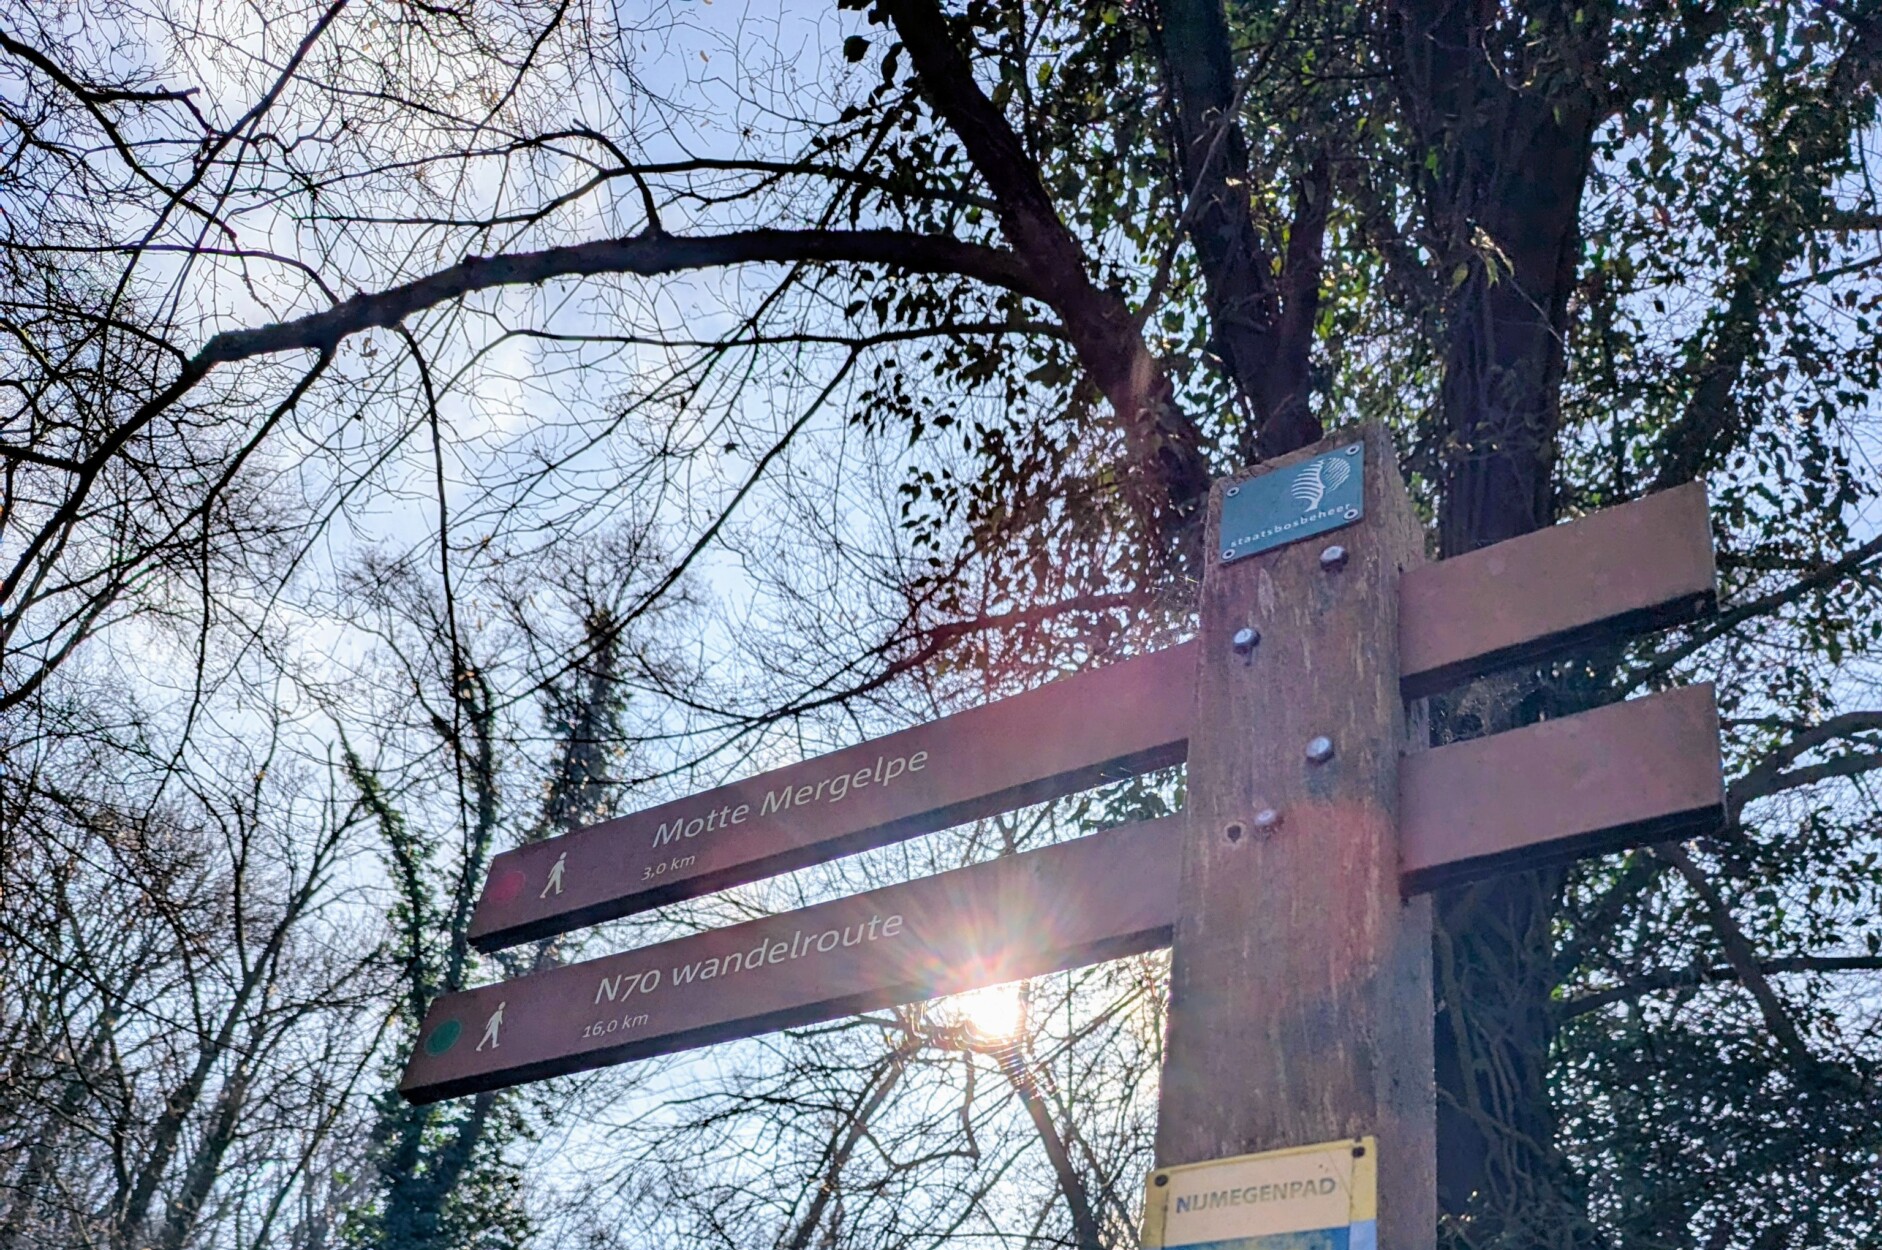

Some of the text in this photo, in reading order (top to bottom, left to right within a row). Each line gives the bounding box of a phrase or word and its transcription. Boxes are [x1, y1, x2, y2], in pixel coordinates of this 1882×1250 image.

[1230, 503, 1350, 548] staatsbosbeheer
[652, 750, 928, 848] Motte Mergelpe
[641, 855, 696, 881] 3,0 km
[594, 914, 903, 1005] N70 wandelroute
[582, 1012, 649, 1038] 16,0 km
[1175, 1177, 1337, 1213] NIJMEGENPAD
